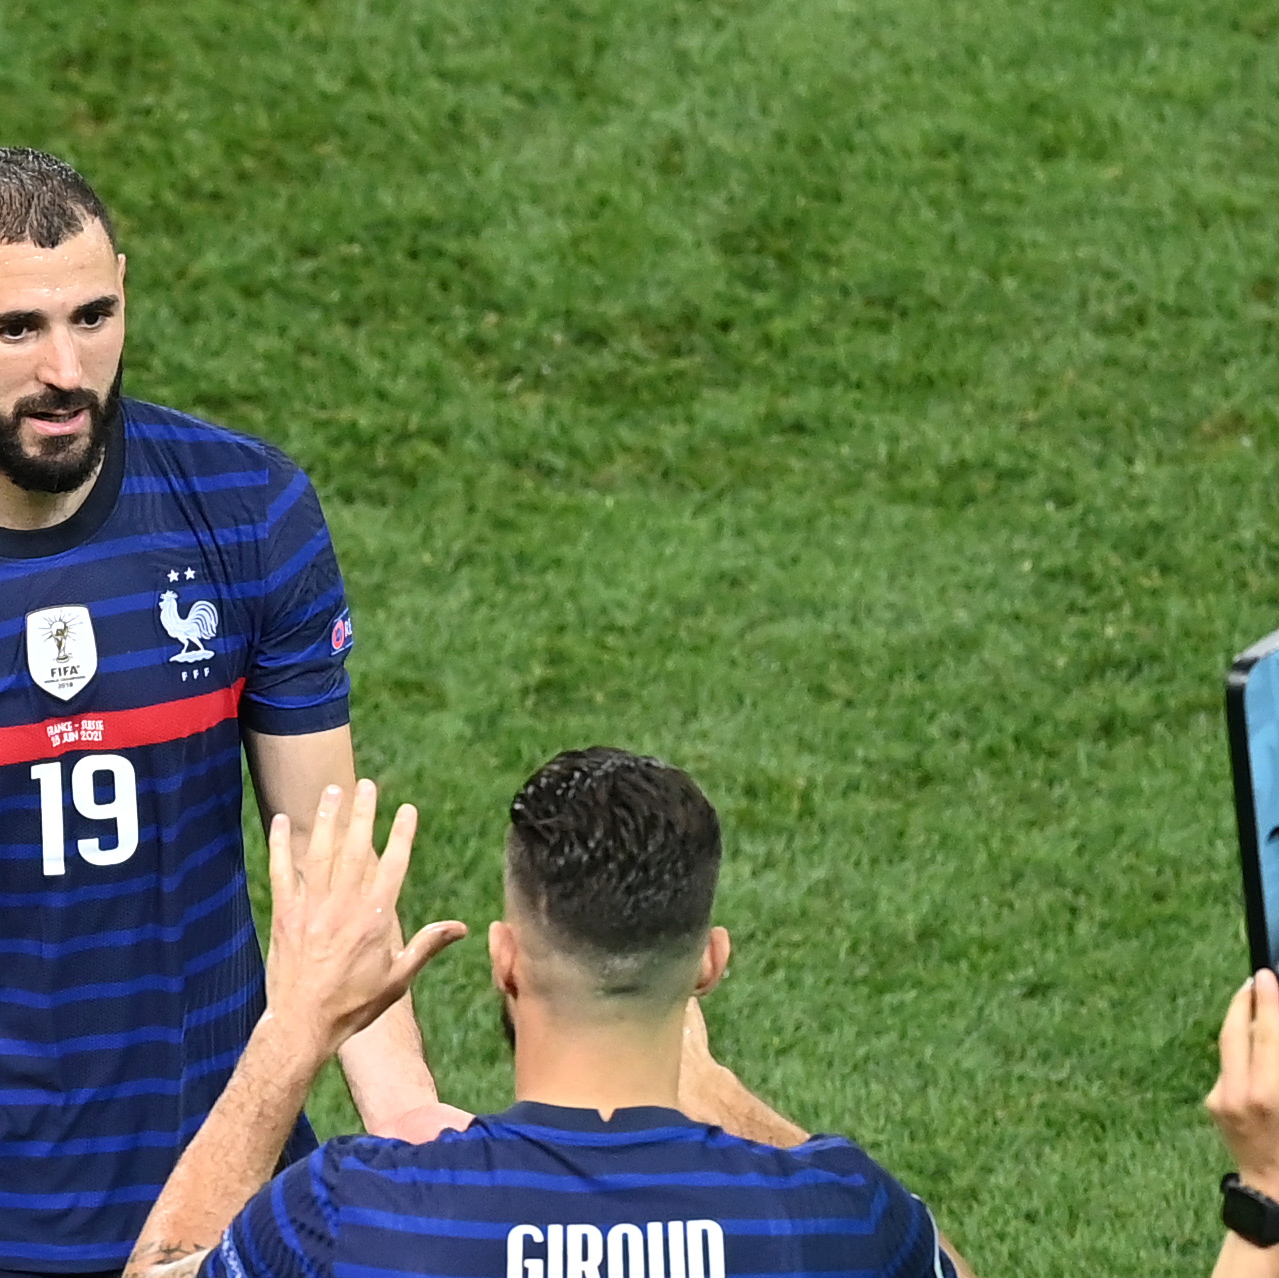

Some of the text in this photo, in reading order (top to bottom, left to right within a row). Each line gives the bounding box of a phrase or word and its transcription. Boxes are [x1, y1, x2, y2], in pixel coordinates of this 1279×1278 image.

[51, 665, 78, 678] FIFA
[46, 721, 73, 737] FRANCE
[80, 730, 102, 741] 2021
[31, 754, 139, 876] 19
